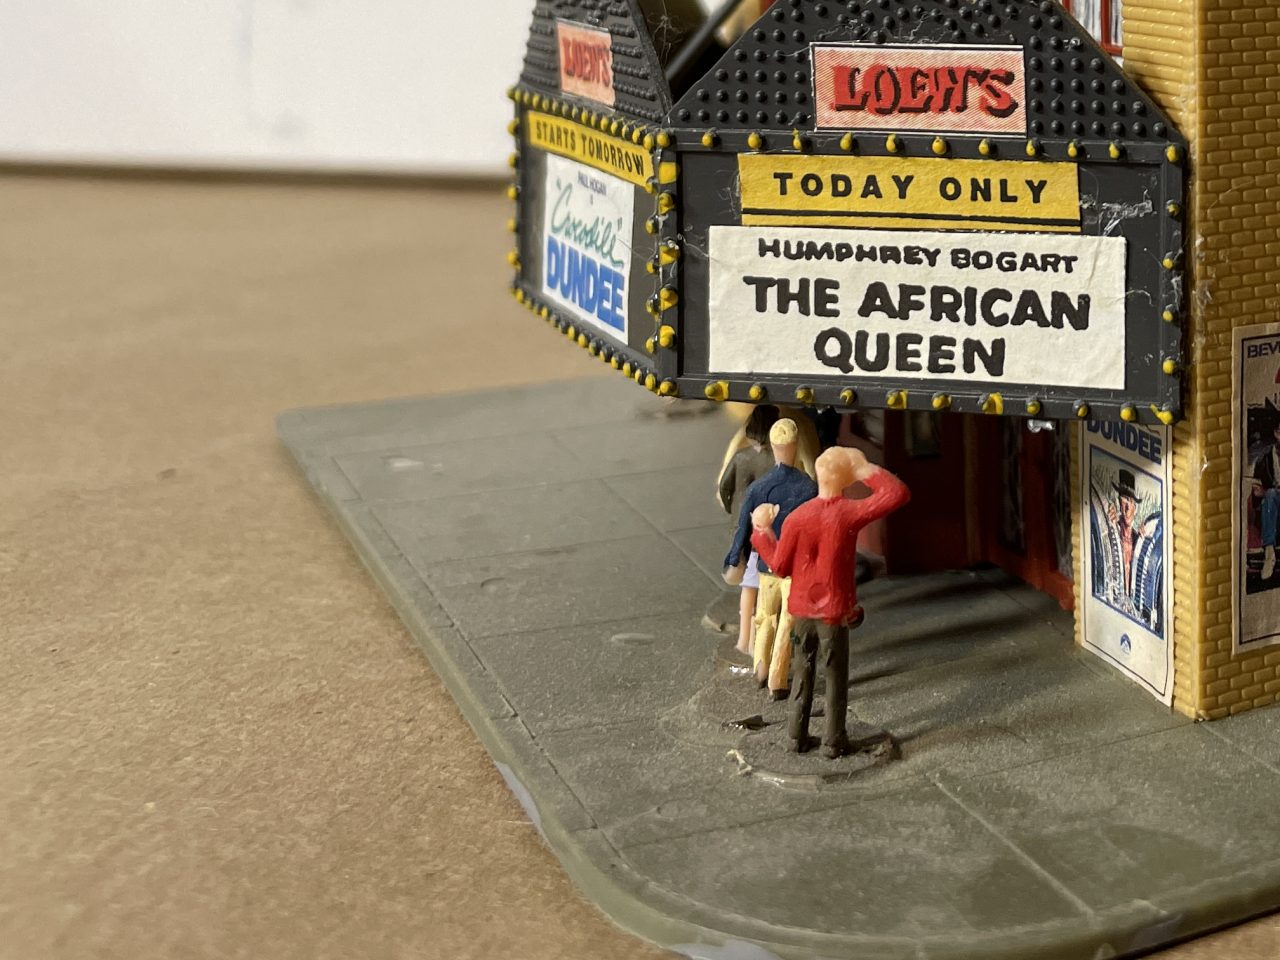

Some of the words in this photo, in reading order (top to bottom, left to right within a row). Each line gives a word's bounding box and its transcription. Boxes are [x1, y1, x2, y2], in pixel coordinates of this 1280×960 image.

[536, 120, 577, 152] STARTS
[581, 133, 645, 177] TOMORROW
[773, 171, 914, 199] TODAY
[939, 176, 1048, 205] ONLY
[758, 237, 941, 268] HUMPHREY
[950, 247, 1078, 274] BOGART
[547, 234, 626, 333] DUNDEE
[743, 275, 840, 318] THE
[857, 281, 1091, 331] AFRICAN
[814, 326, 1006, 377] QUEEN
